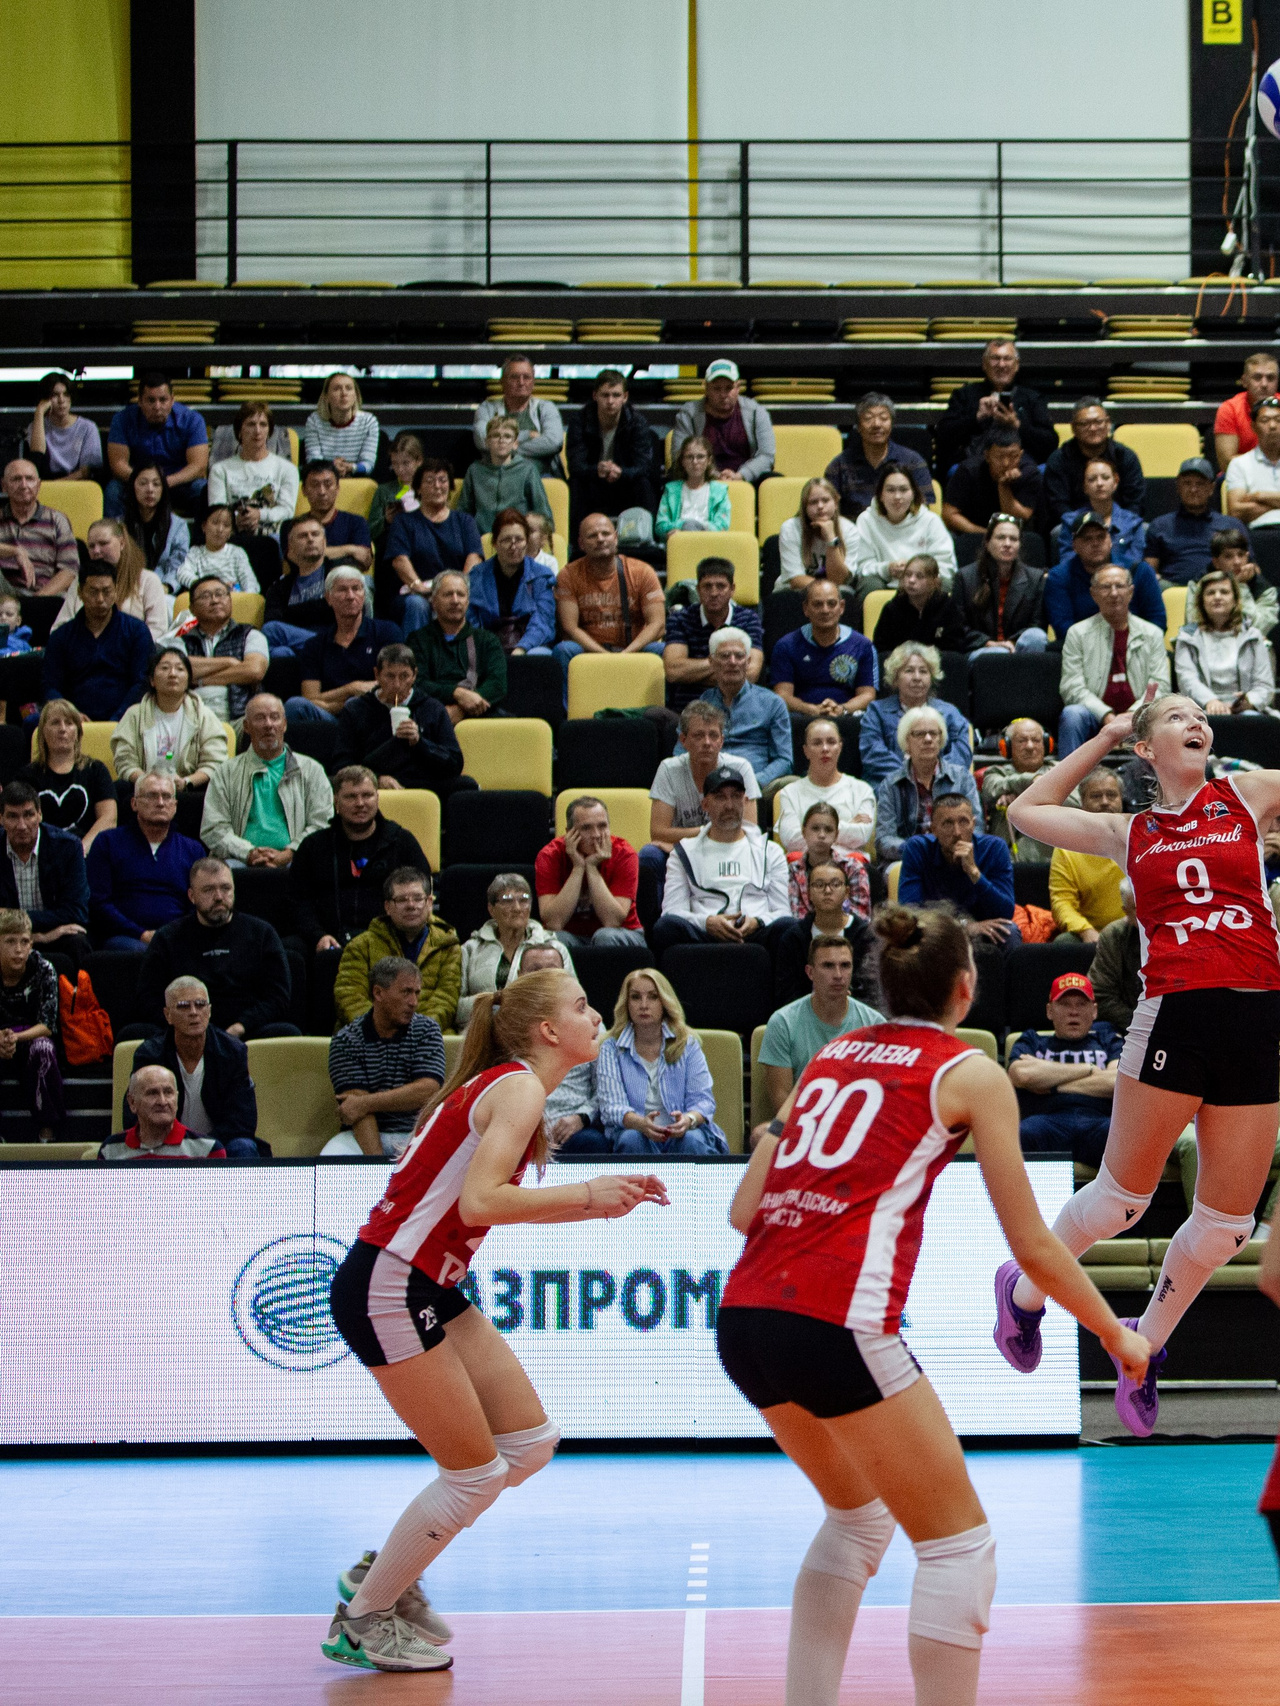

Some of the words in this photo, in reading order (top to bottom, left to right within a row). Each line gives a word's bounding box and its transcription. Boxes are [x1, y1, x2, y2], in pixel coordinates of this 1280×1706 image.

[1176, 857, 1214, 905] 9
[1058, 976, 1086, 990] СССР
[1152, 1050, 1168, 1071] 9
[774, 1077, 884, 1170] 30
